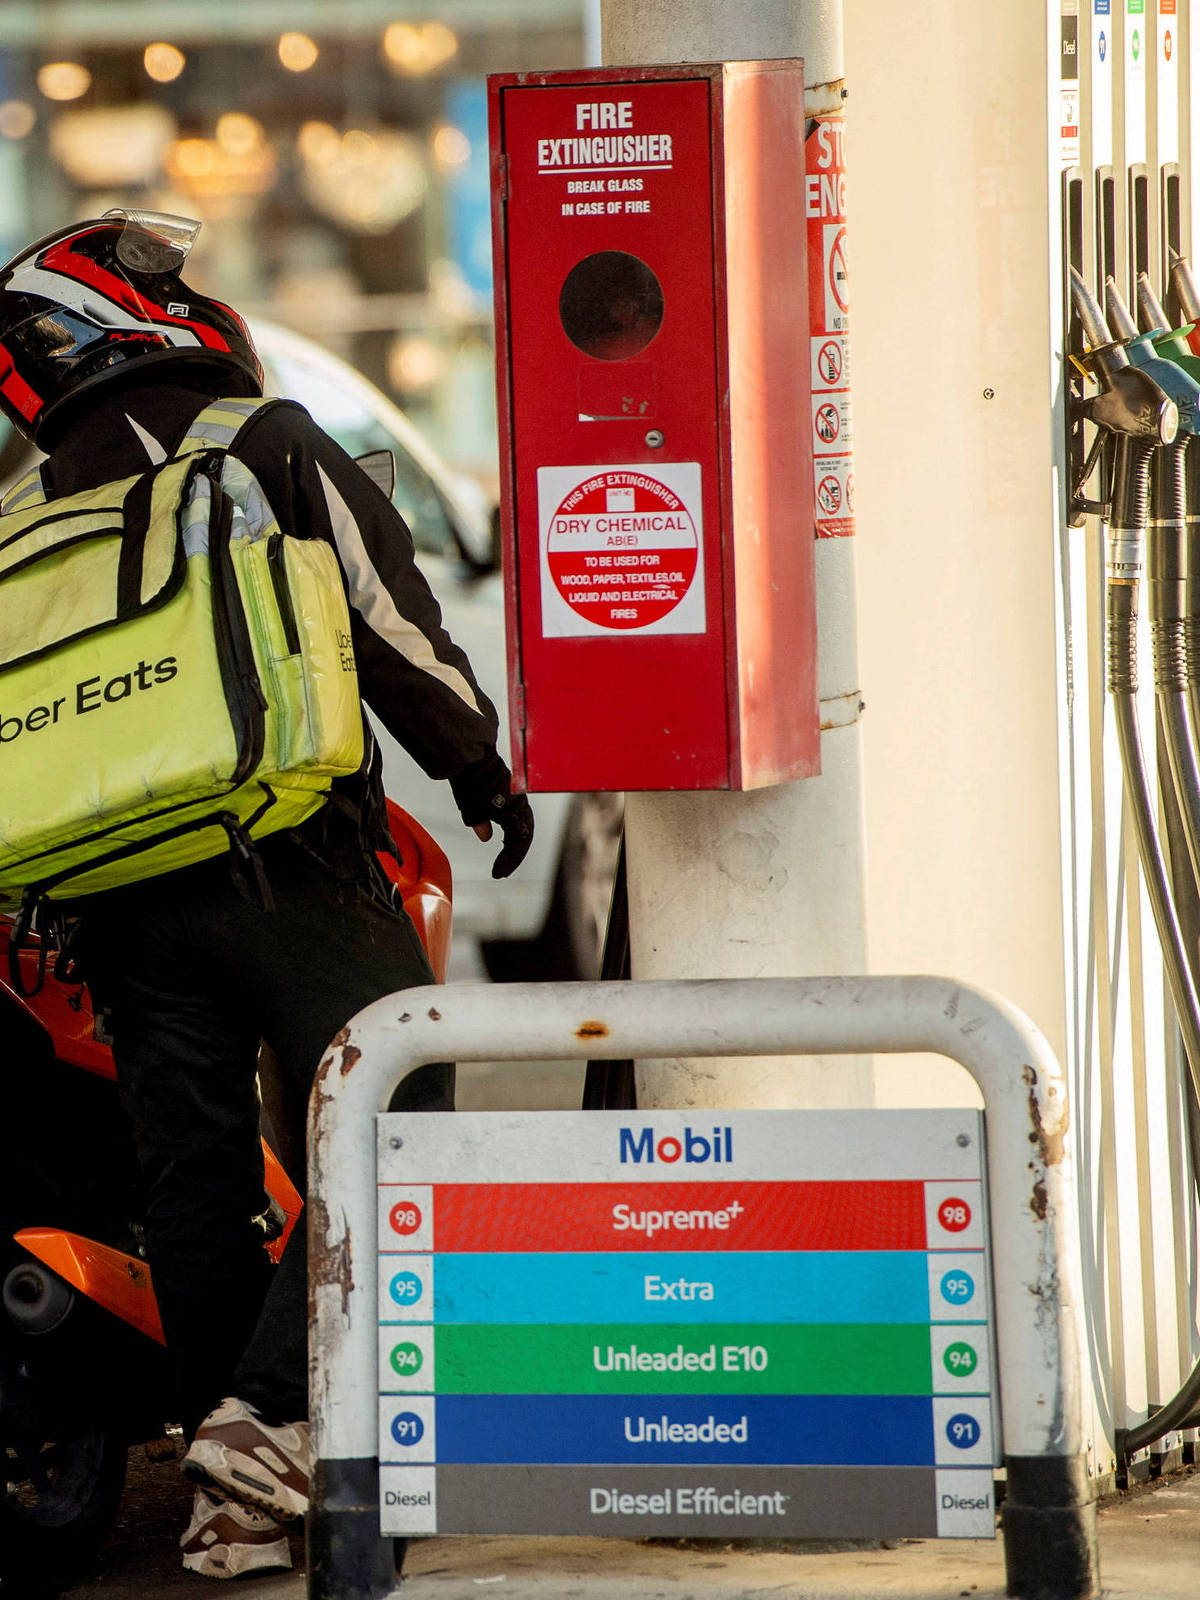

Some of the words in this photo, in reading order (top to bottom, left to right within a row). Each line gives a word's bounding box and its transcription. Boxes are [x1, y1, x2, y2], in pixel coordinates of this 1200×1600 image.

[576, 101, 633, 130] FIRE
[538, 134, 672, 166] EXTINGUISHER
[567, 181, 605, 194] BREAK
[608, 178, 643, 192] GLASS
[561, 203, 574, 216] IN
[576, 202, 605, 215] CASE
[607, 201, 622, 214] OF
[625, 200, 651, 213] FIRE
[562, 491, 584, 512] THIS
[582, 477, 606, 495] FIRE
[606, 473, 680, 510] EXTINGUISHER
[556, 519, 590, 534] DRY
[596, 516, 687, 532] CHEMICAL
[606, 535, 638, 547] AB(E)
[584, 557, 598, 567] TO
[599, 557, 612, 566] BE
[613, 556, 639, 566] USED
[640, 555, 660, 565] FOR
[568, 592, 600, 602] LIQUID
[600, 591, 621, 602] AND
[621, 590, 679, 601] ELECTRICAL
[610, 608, 638, 619] FIRES
[75, 655, 178, 716] Eats
[619, 1127, 733, 1164] Mobil
[395, 1210, 417, 1227] 98
[943, 1206, 967, 1224] 98
[396, 1281, 417, 1297] 95
[644, 1275, 714, 1301] Extra
[946, 1279, 969, 1296] 95
[396, 1351, 418, 1368] 94
[593, 1344, 717, 1372] Unleaded
[722, 1346, 768, 1372] E10
[949, 1351, 973, 1368] 94
[397, 1420, 417, 1438] 91
[624, 1415, 749, 1443] Unleaded
[952, 1422, 973, 1440] 91
[385, 1491, 432, 1506] Diesel
[590, 1487, 672, 1515] Diesel
[941, 1494, 990, 1510] Diesel
